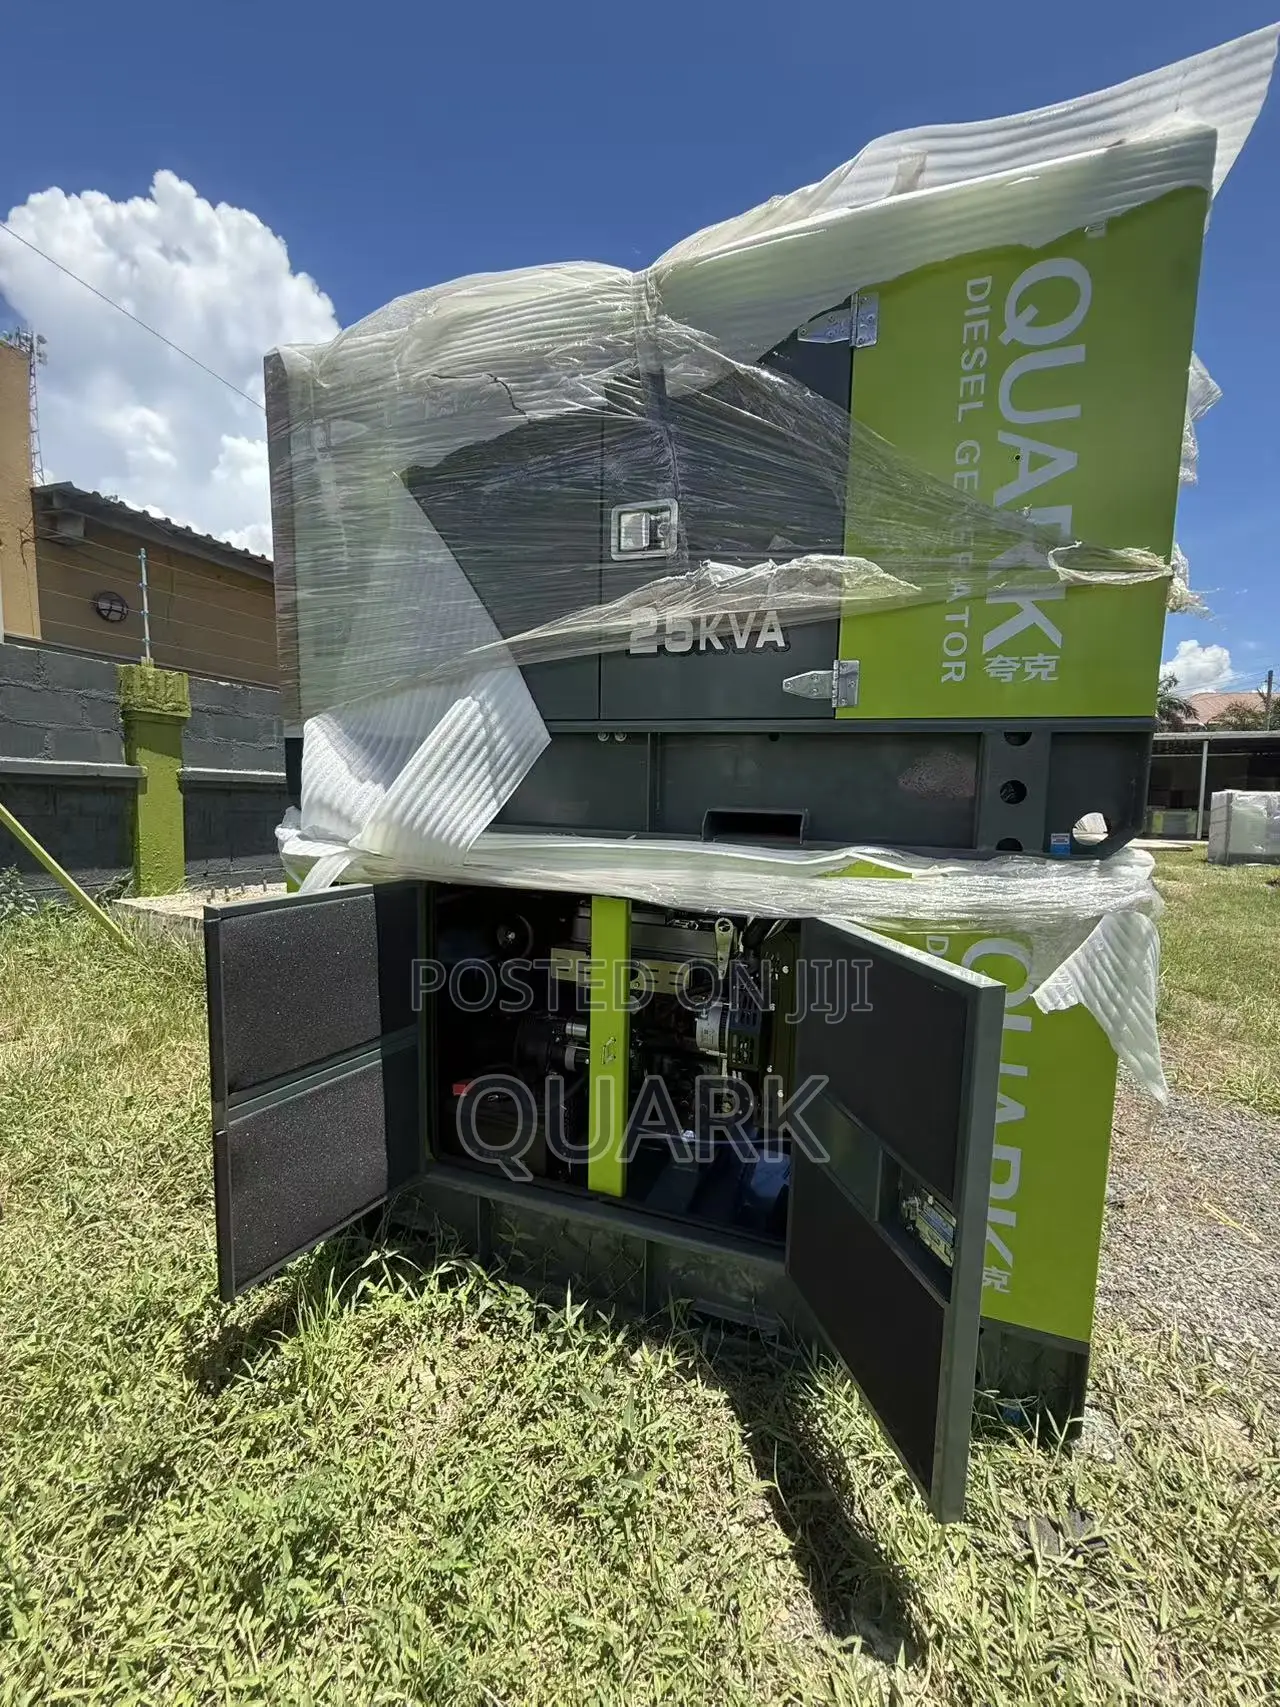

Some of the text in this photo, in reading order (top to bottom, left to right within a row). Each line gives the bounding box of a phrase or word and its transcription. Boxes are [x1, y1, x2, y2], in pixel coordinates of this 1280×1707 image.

[940, 275, 993, 683] DIESEL GEERATOR
[982, 257, 1092, 655] QUARK
[629, 607, 786, 654] 25KVA
[983, 652, 1060, 683] 夸克
